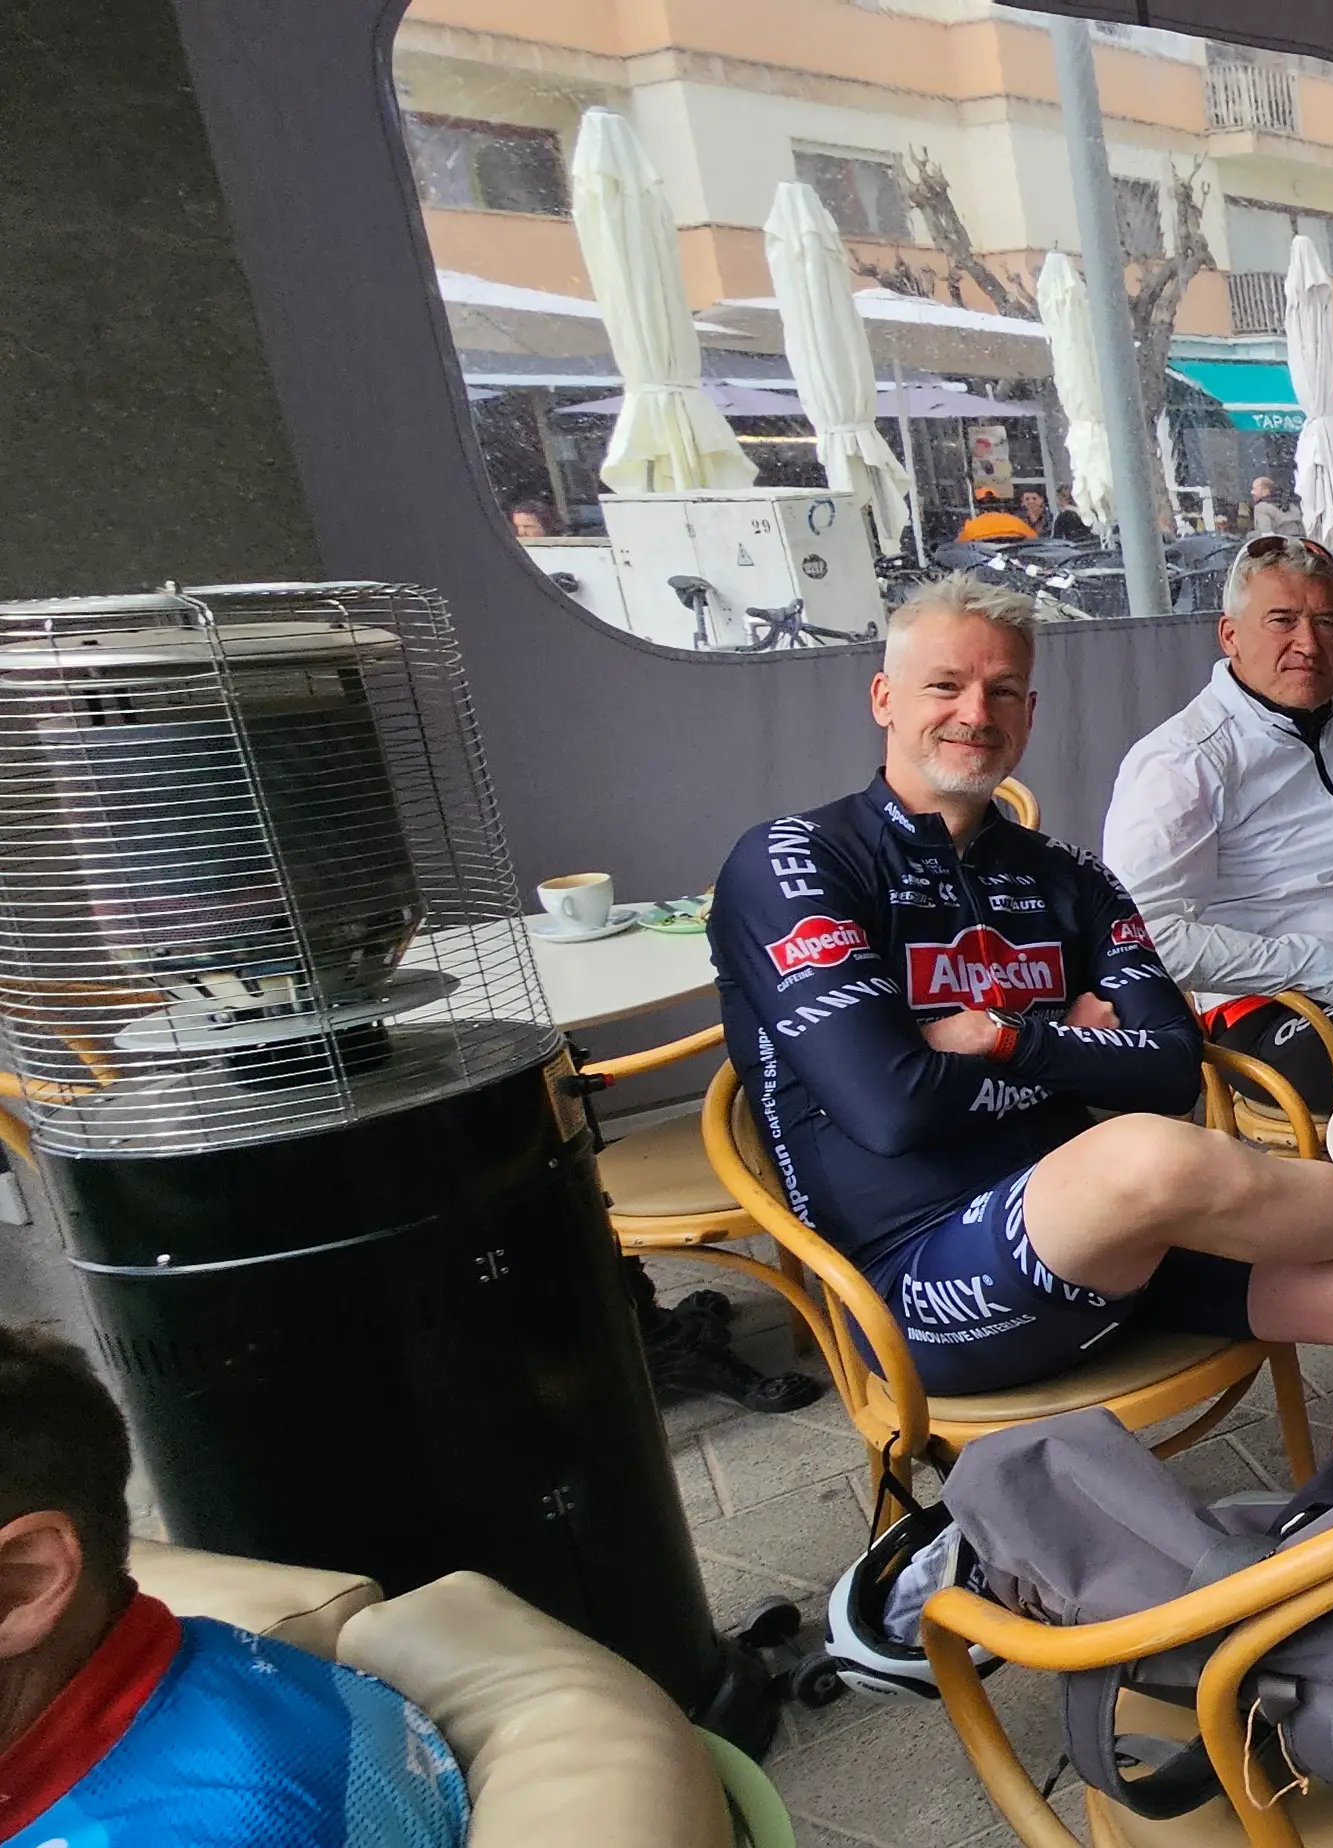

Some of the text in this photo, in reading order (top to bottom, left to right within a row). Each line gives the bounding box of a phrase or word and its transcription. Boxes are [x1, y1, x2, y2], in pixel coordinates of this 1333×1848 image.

[1252, 413, 1303, 431] TAPAS
[751, 519, 771, 534] 29
[884, 802, 916, 834] Alpecin
[768, 815, 824, 899] FENIX
[783, 926, 862, 966] Alpecin
[776, 967, 816, 993] CAFFEINE
[929, 952, 1054, 1003] Alpecin
[902, 1273, 1013, 1325] FENIX
[907, 1313, 1037, 1345] INNOVATIVE MATERIALS
